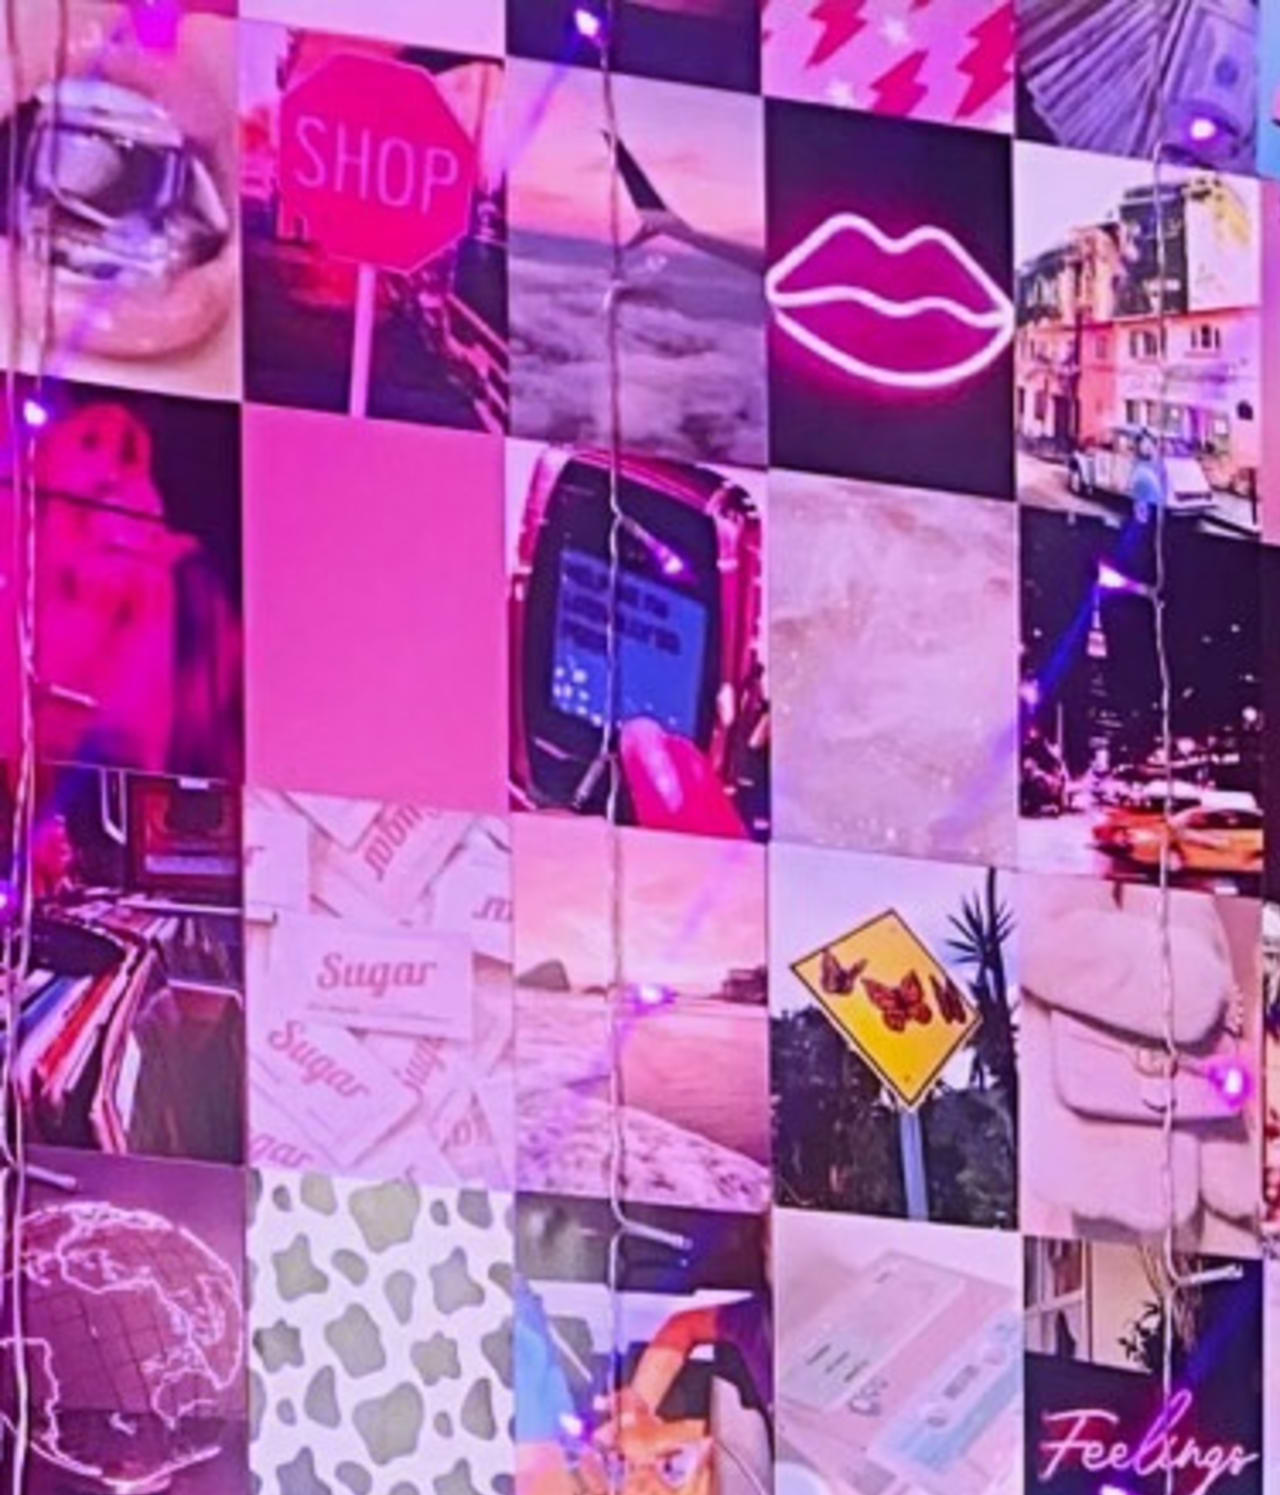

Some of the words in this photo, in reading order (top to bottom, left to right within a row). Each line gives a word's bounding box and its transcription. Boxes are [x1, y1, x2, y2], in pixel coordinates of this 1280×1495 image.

[295, 116, 460, 216] SHOP
[317, 953, 437, 997] Sugar
[266, 1019, 370, 1098] Sugar
